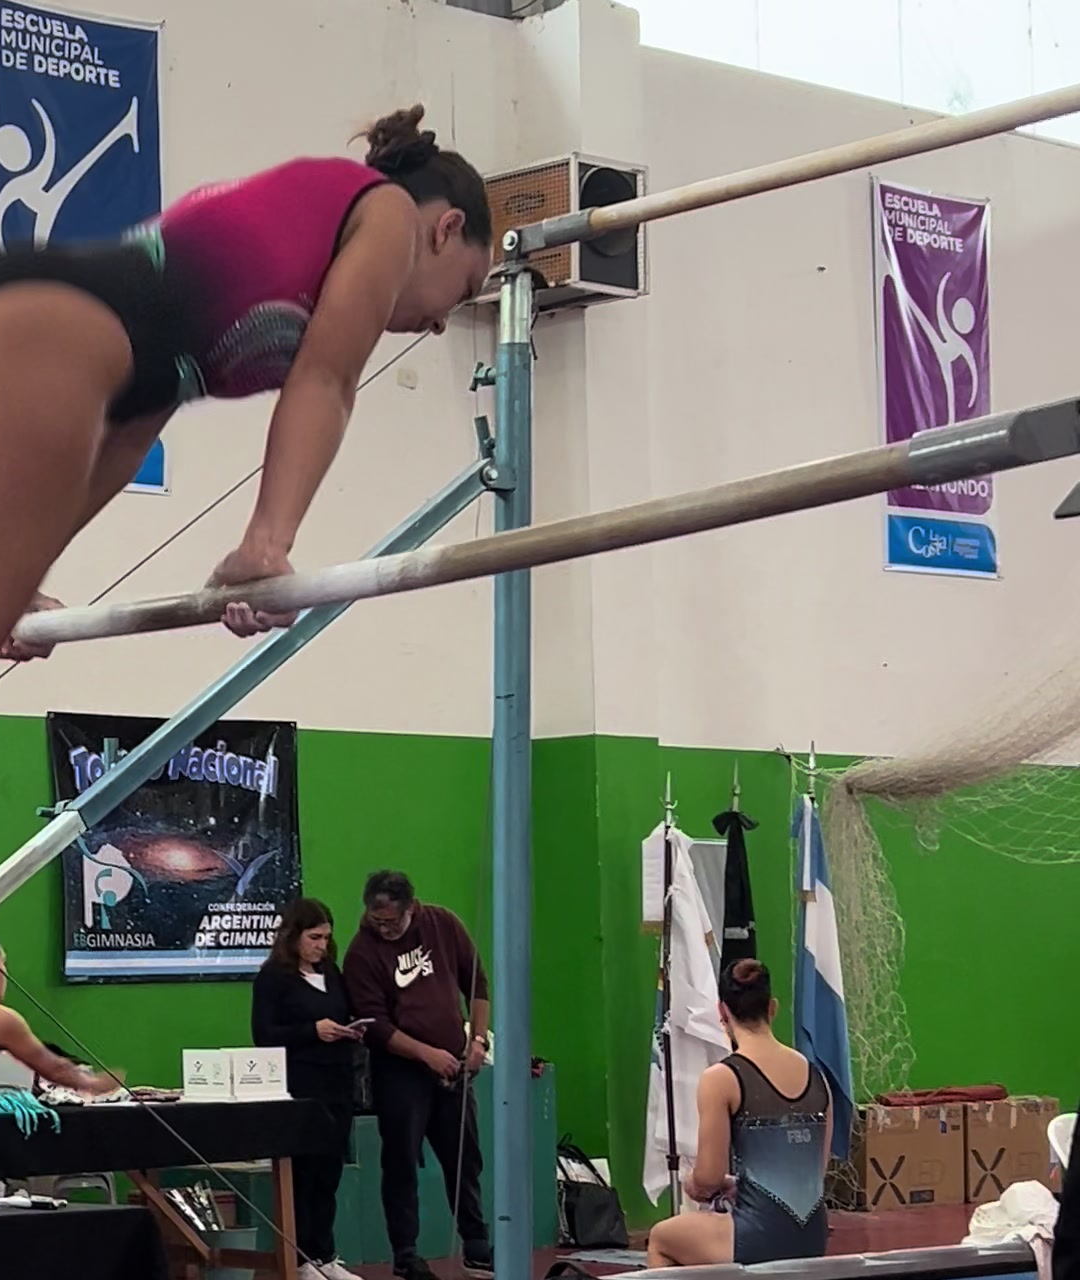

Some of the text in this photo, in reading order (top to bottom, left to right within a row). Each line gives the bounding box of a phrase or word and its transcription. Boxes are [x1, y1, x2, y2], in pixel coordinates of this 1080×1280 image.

[1, 8, 88, 42] ESCUELA
[1, 29, 104, 66] MUNICIPAL
[2, 49, 121, 88] DE DEPORTE
[885, 193, 941, 217] ESCUELA
[885, 209, 952, 235] MUNICIPAL
[906, 228, 964, 253] DEPORTE
[208, 901, 275, 912] CONFEDERACIÓN
[199, 915, 283, 930] ARGENTINA
[195, 932, 216, 947] DE
